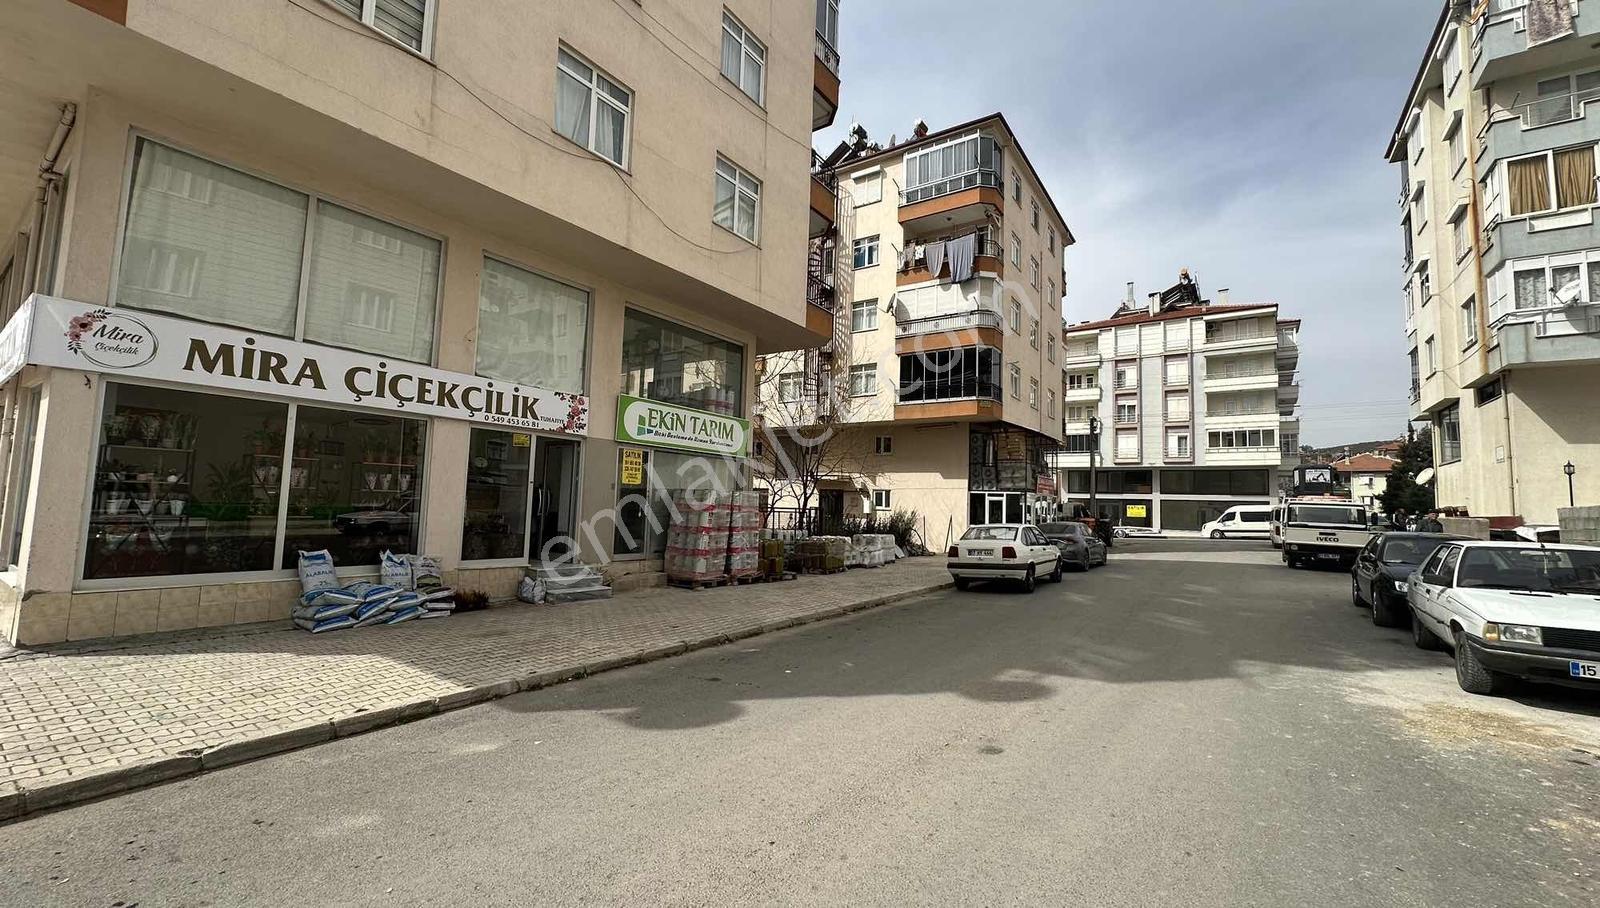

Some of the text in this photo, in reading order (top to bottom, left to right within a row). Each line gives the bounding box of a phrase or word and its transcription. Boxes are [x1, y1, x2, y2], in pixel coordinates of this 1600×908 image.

[92, 324, 144, 344] Mira
[94, 341, 139, 355] Çiçekçilik
[182, 337, 541, 420] MİRA ÇİÇEKÇİLİK
[491, 415, 505, 423] 549
[506, 417, 520, 426] 453
[521, 419, 530, 427] 65
[689, 415, 735, 442] TARIM
[1580, 664, 1597, 676] 15
